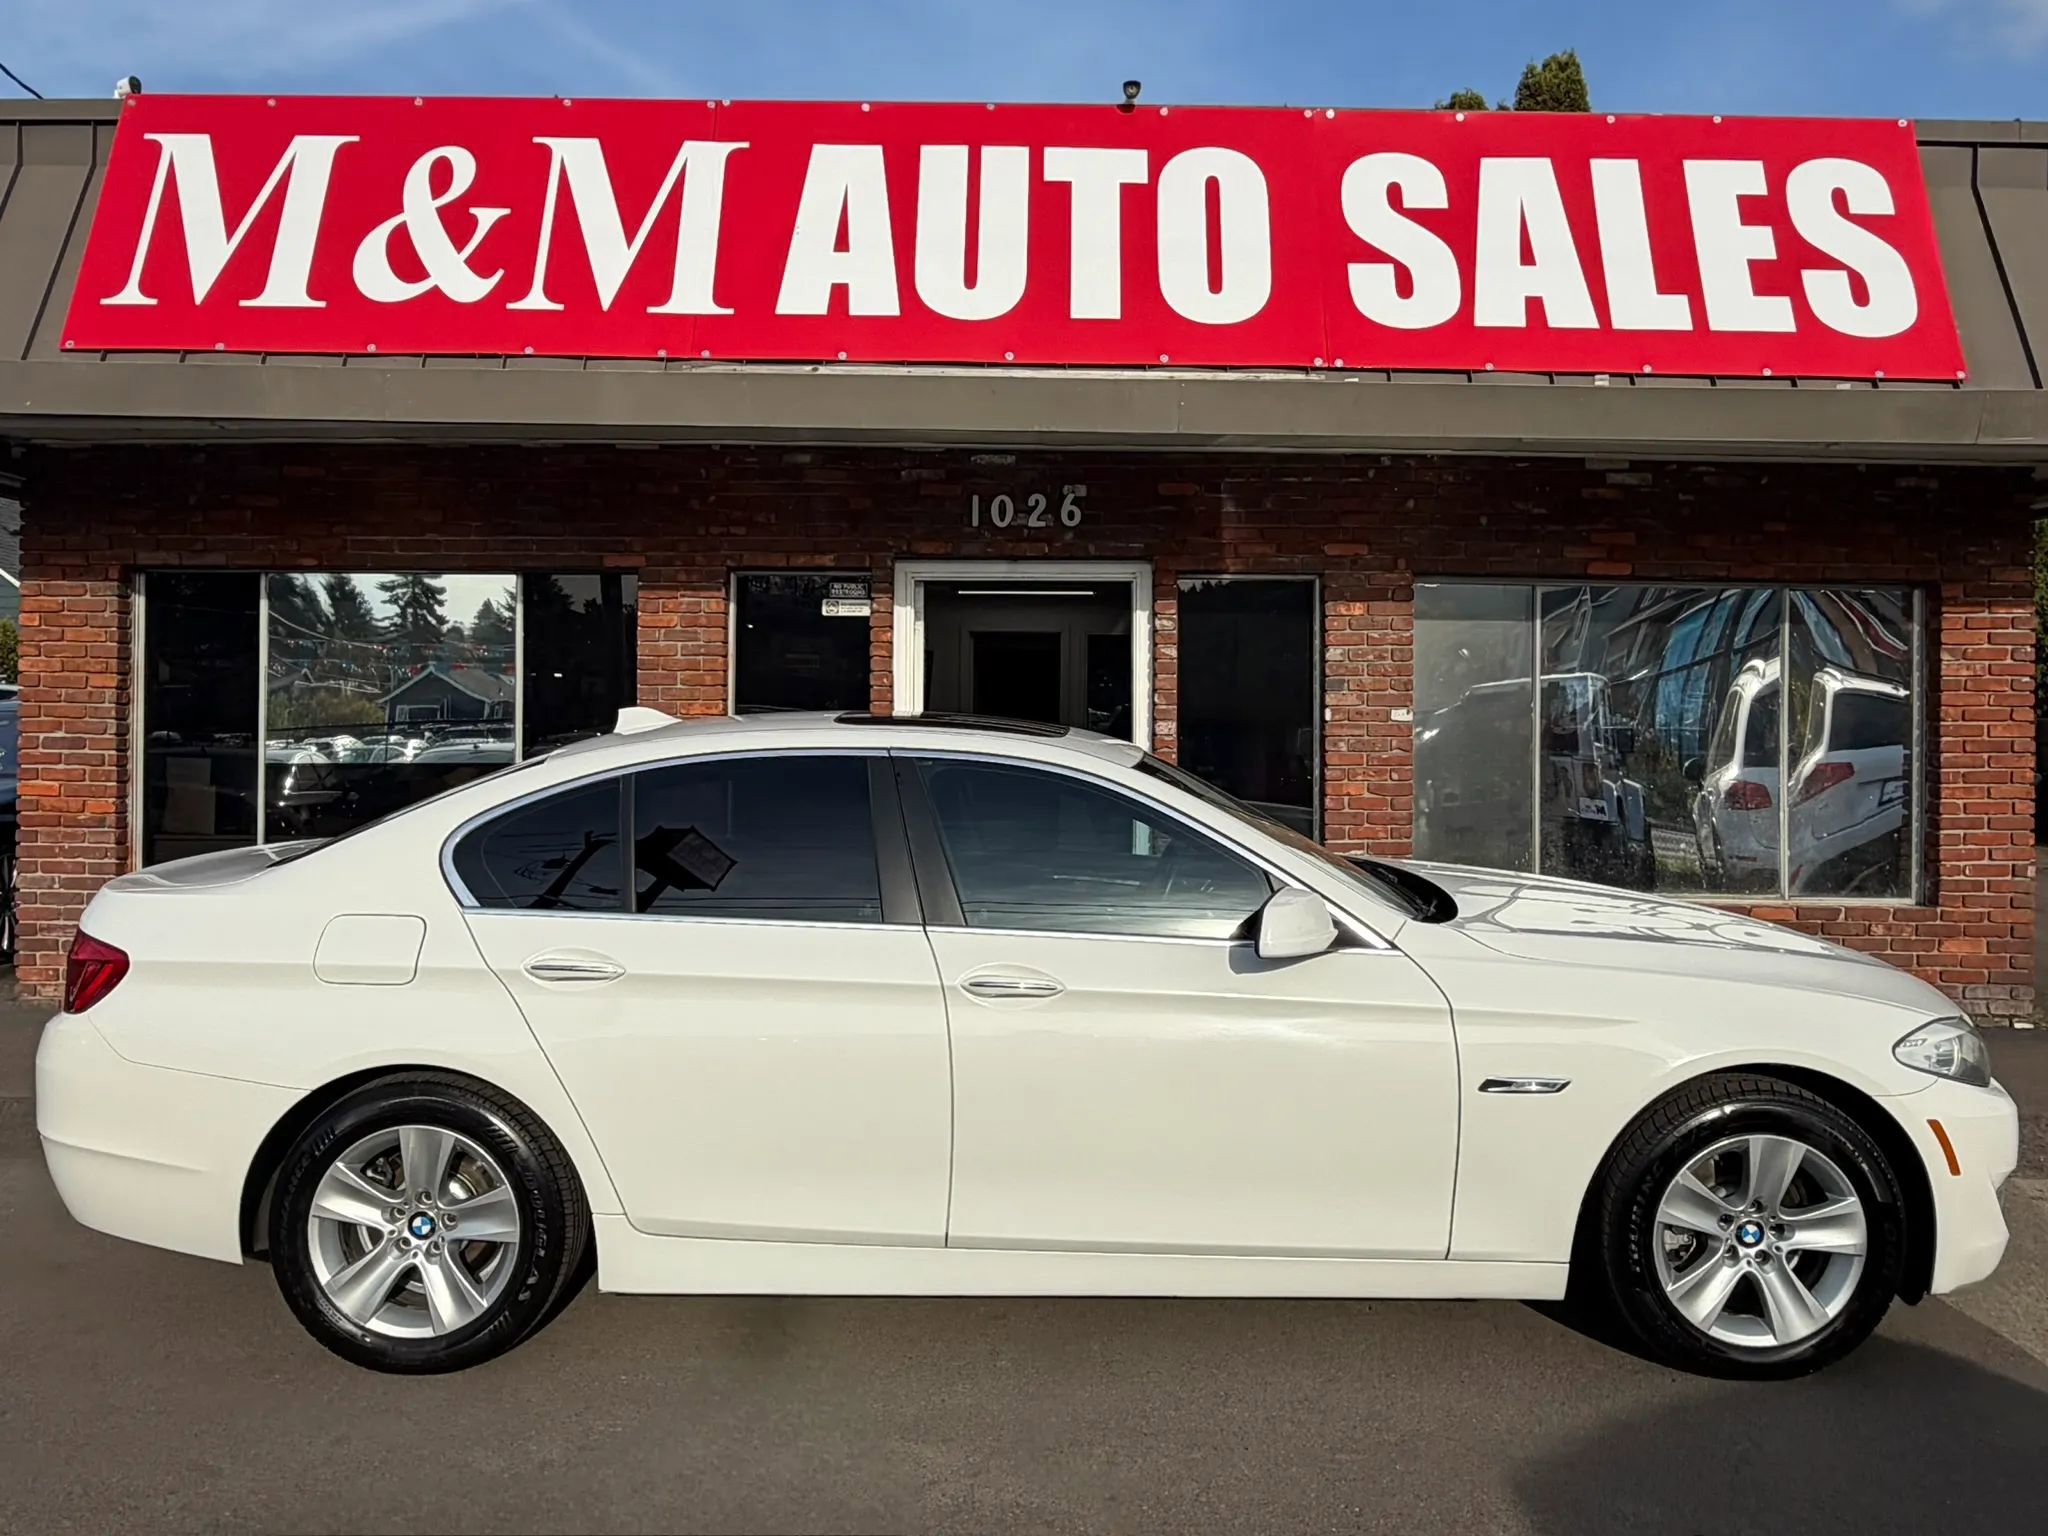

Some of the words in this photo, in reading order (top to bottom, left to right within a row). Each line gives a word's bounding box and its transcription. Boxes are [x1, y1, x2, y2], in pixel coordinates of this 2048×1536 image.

[100, 134, 749, 314] M&M
[775, 144, 1271, 324] AUTO
[1341, 153, 1917, 337] SALES
[971, 493, 1082, 528] 1026
